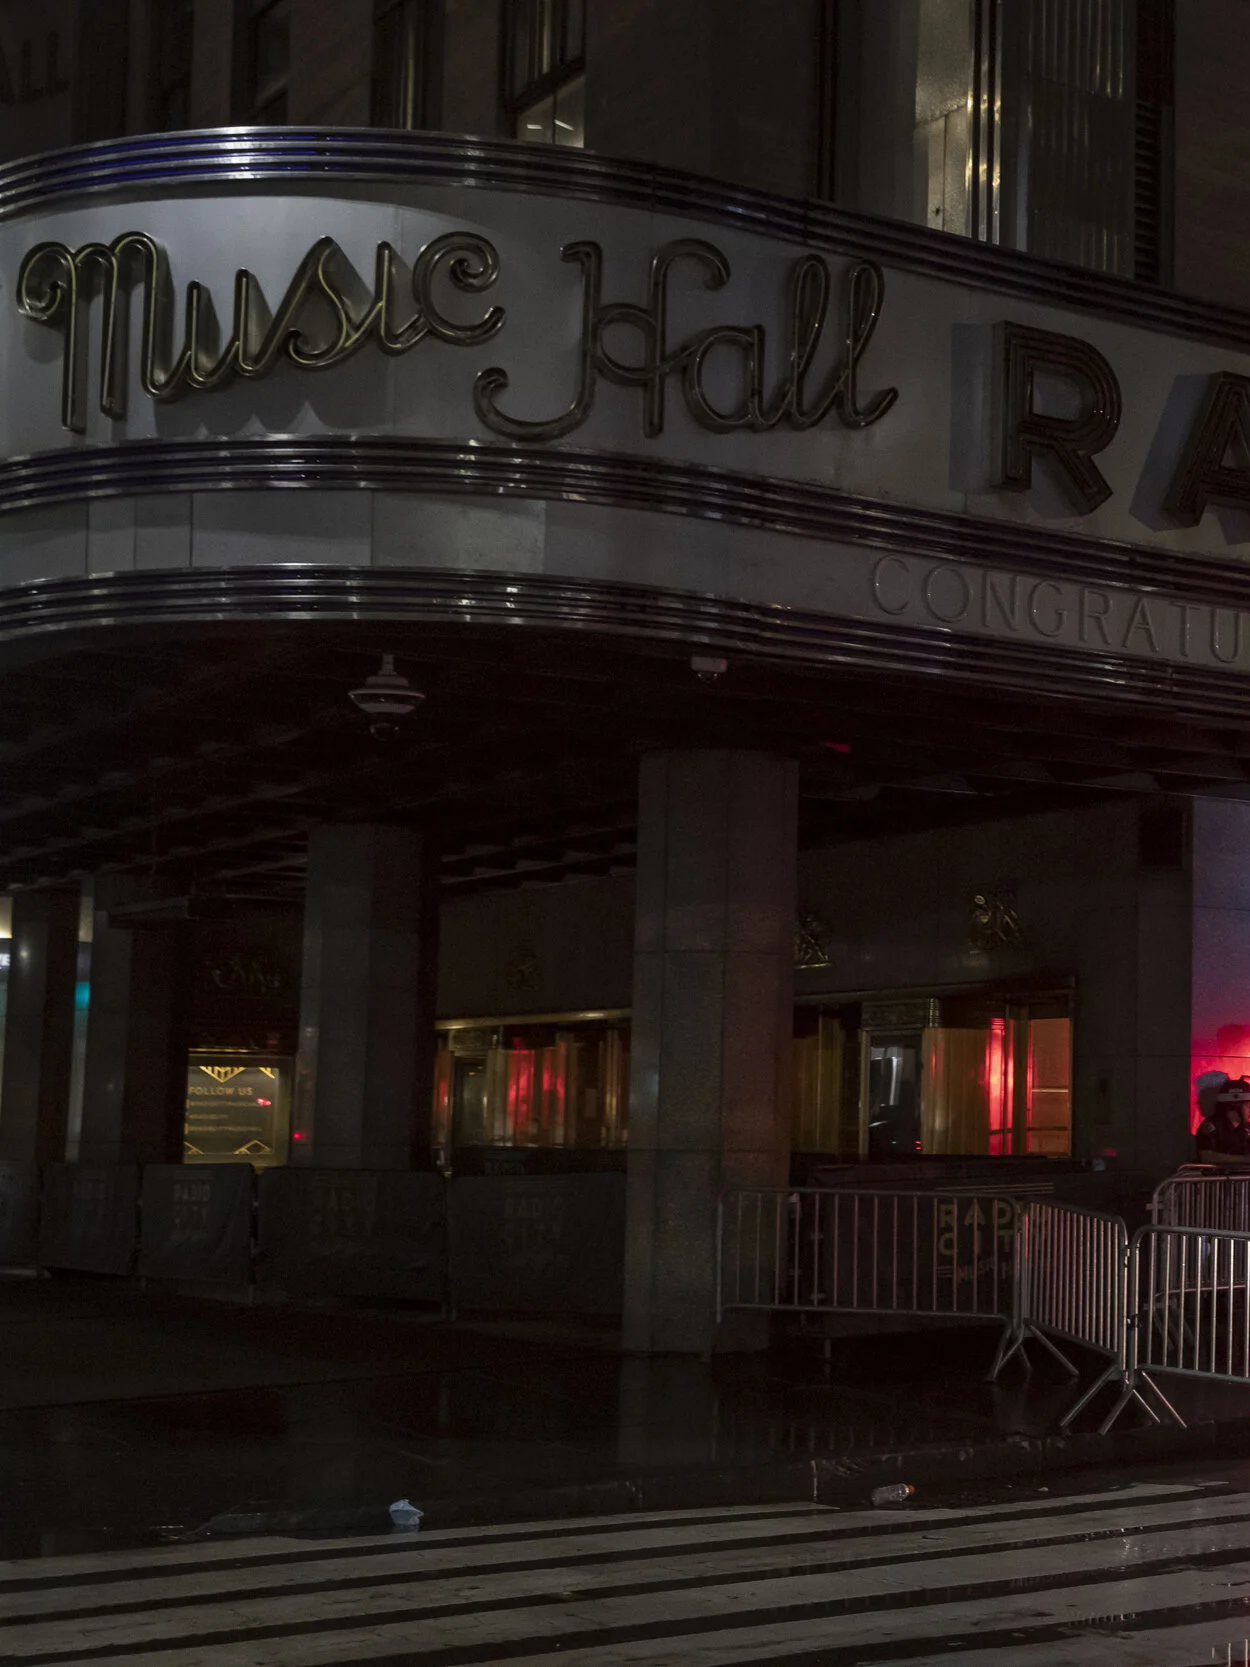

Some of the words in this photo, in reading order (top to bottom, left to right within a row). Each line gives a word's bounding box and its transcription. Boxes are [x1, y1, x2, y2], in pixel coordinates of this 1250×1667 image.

[475, 238, 900, 442] Hall
[188, 1086, 235, 1096] FOLLOW
[237, 1086, 254, 1096] US
